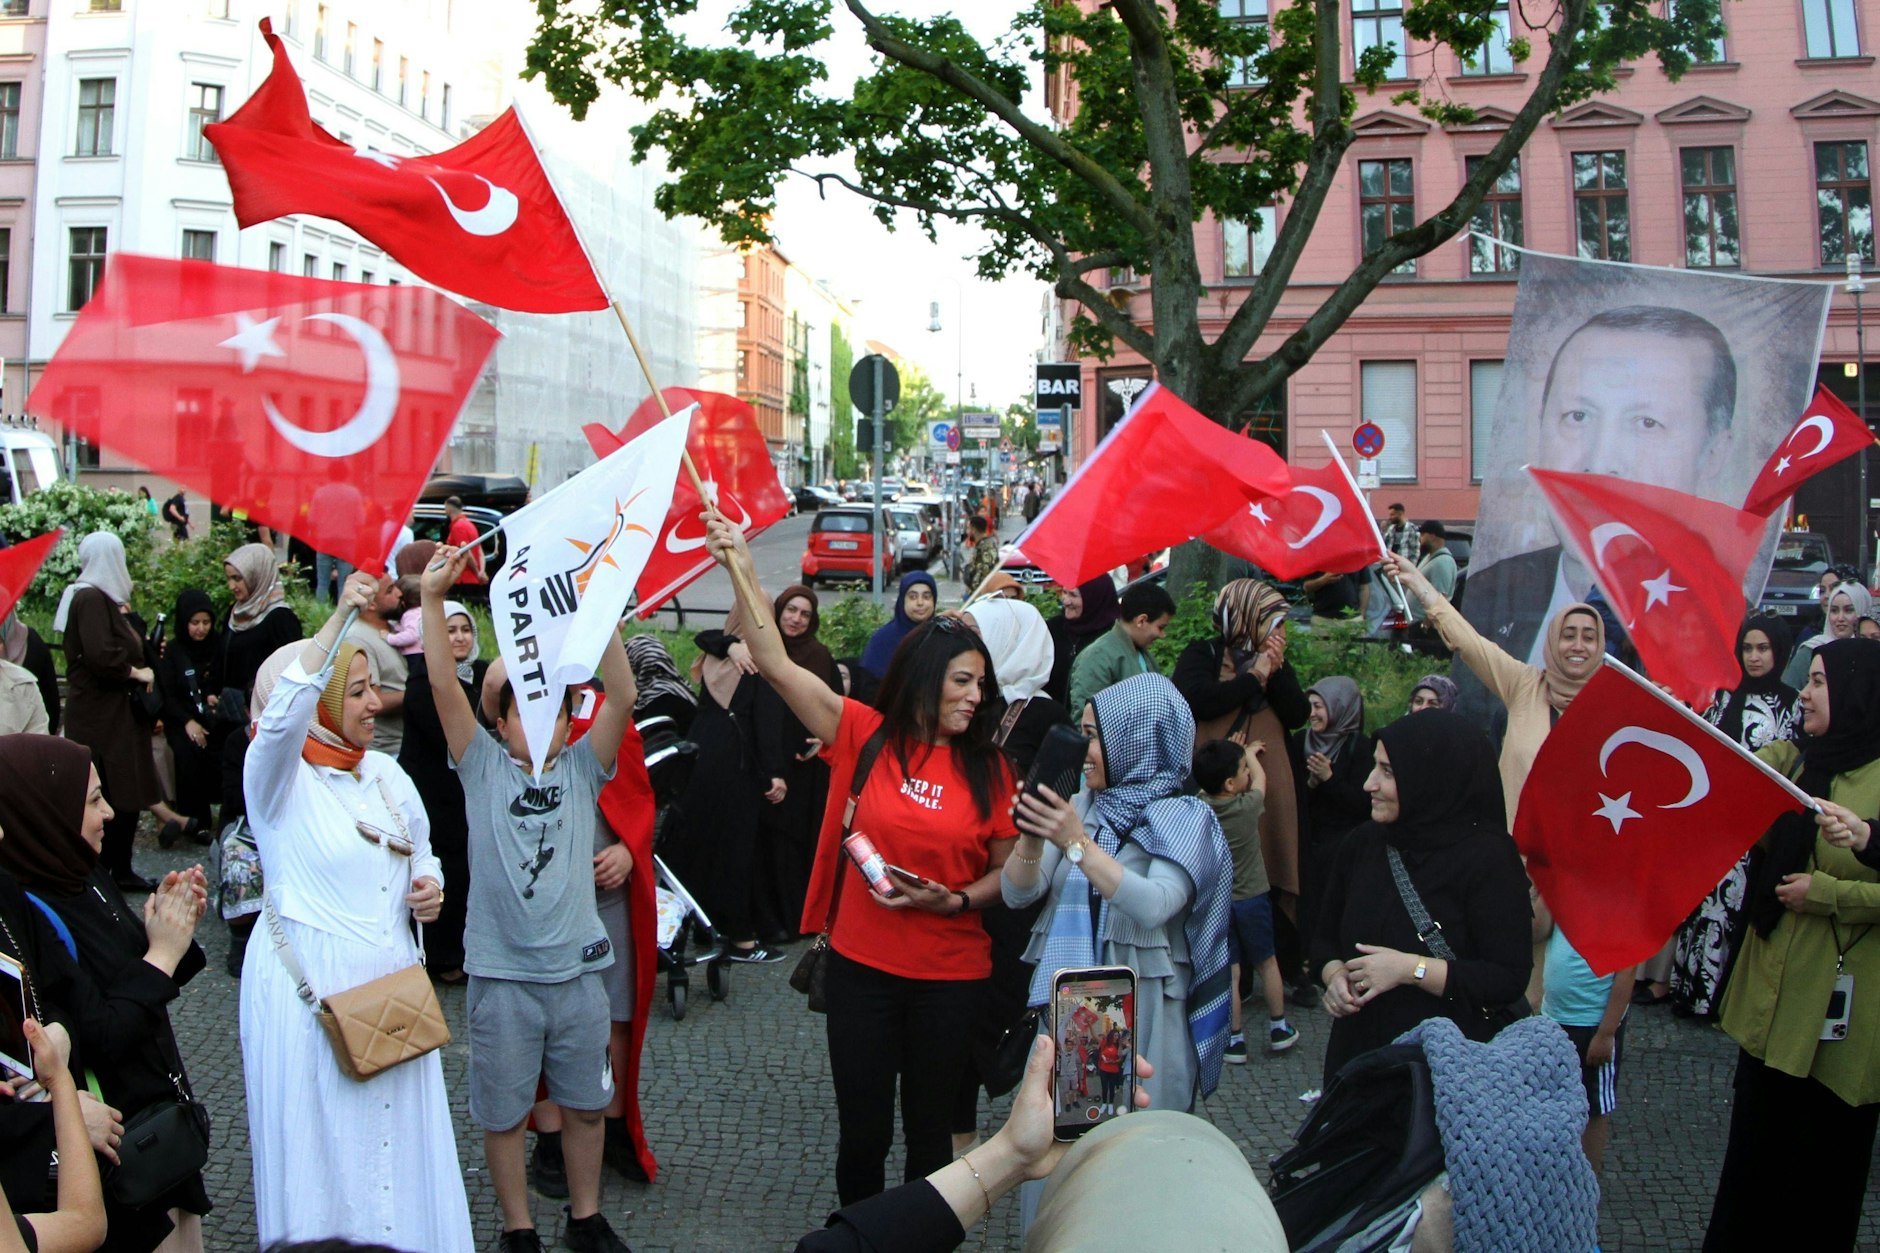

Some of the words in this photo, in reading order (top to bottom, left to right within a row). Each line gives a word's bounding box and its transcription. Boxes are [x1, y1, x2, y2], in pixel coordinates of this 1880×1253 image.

[1037, 378, 1080, 395] BAR
[508, 544, 531, 581] AK
[521, 785, 560, 809] NIKE
[900, 782, 943, 810] SIMPLE.
[902, 777, 929, 795] EEP
[931, 784, 944, 798] IT
